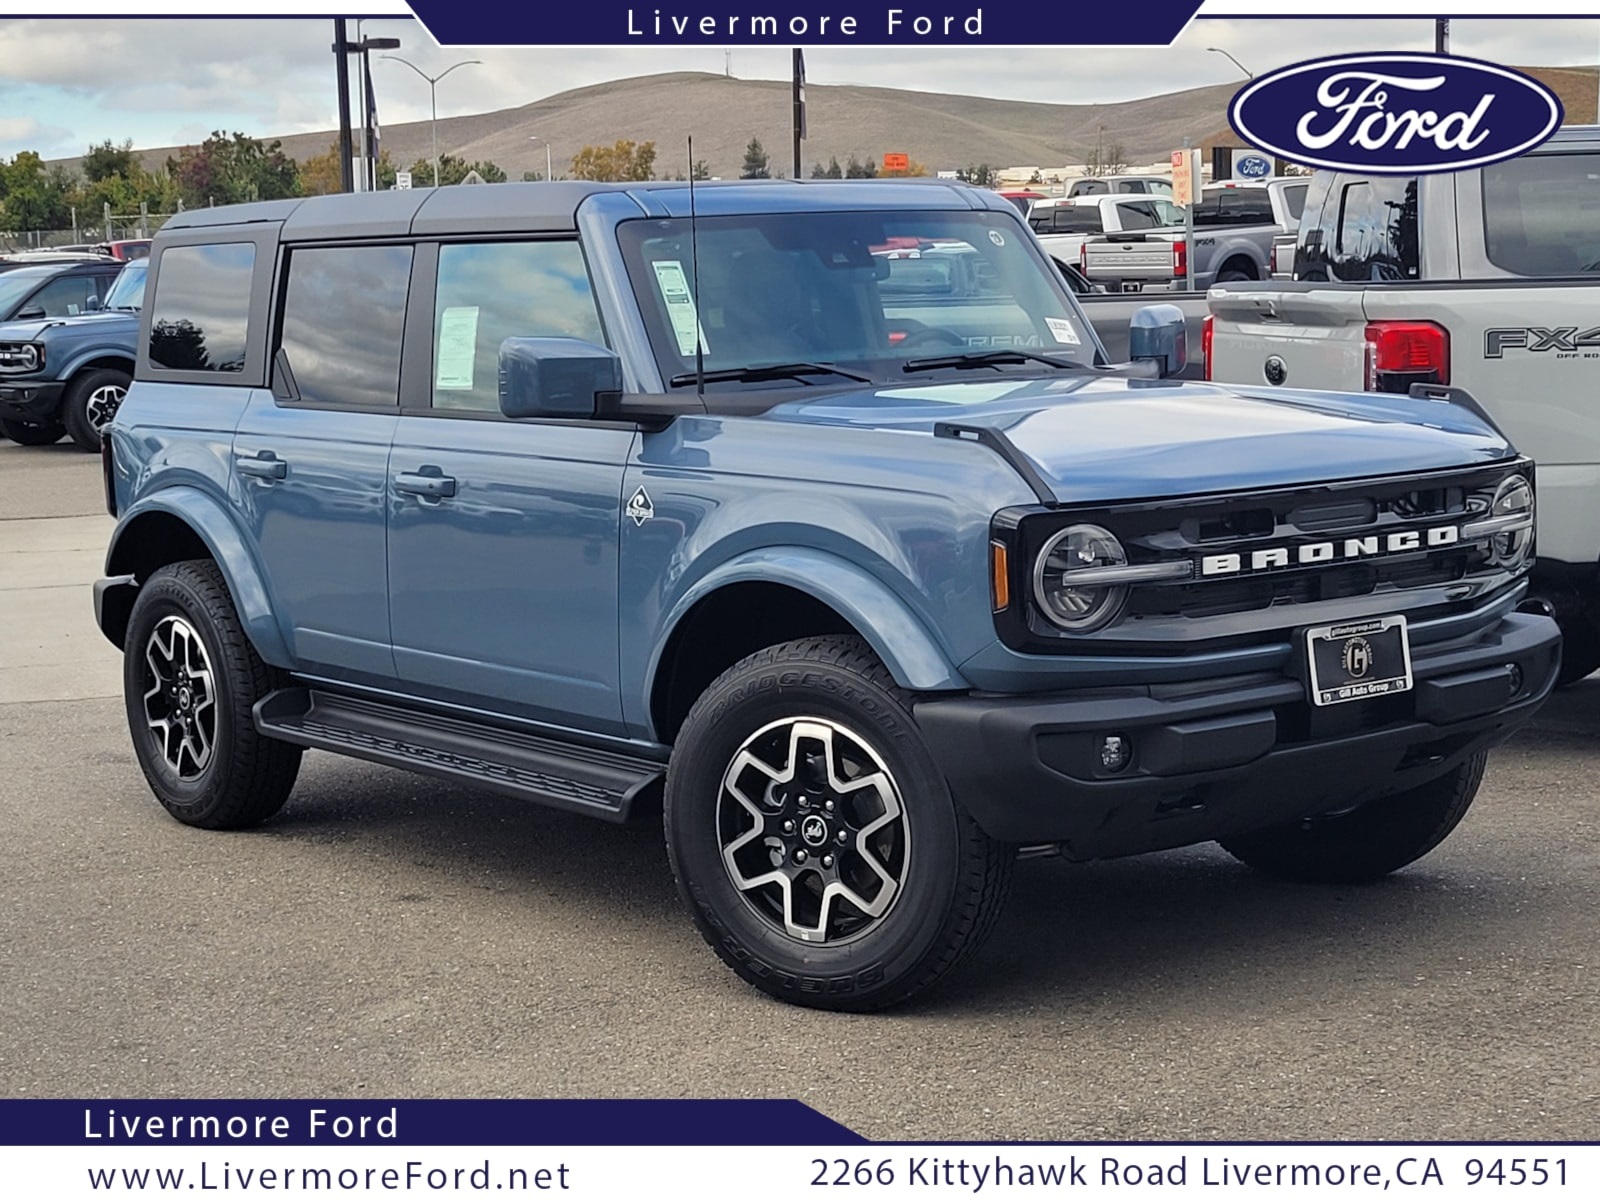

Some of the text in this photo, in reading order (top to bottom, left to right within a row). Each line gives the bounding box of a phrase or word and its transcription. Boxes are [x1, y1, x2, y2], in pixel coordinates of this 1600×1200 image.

[1242, 158, 1265, 174] Ford
[1202, 525, 1459, 576] BRONCO
[1339, 682, 1390, 698] Gill Auto Group
